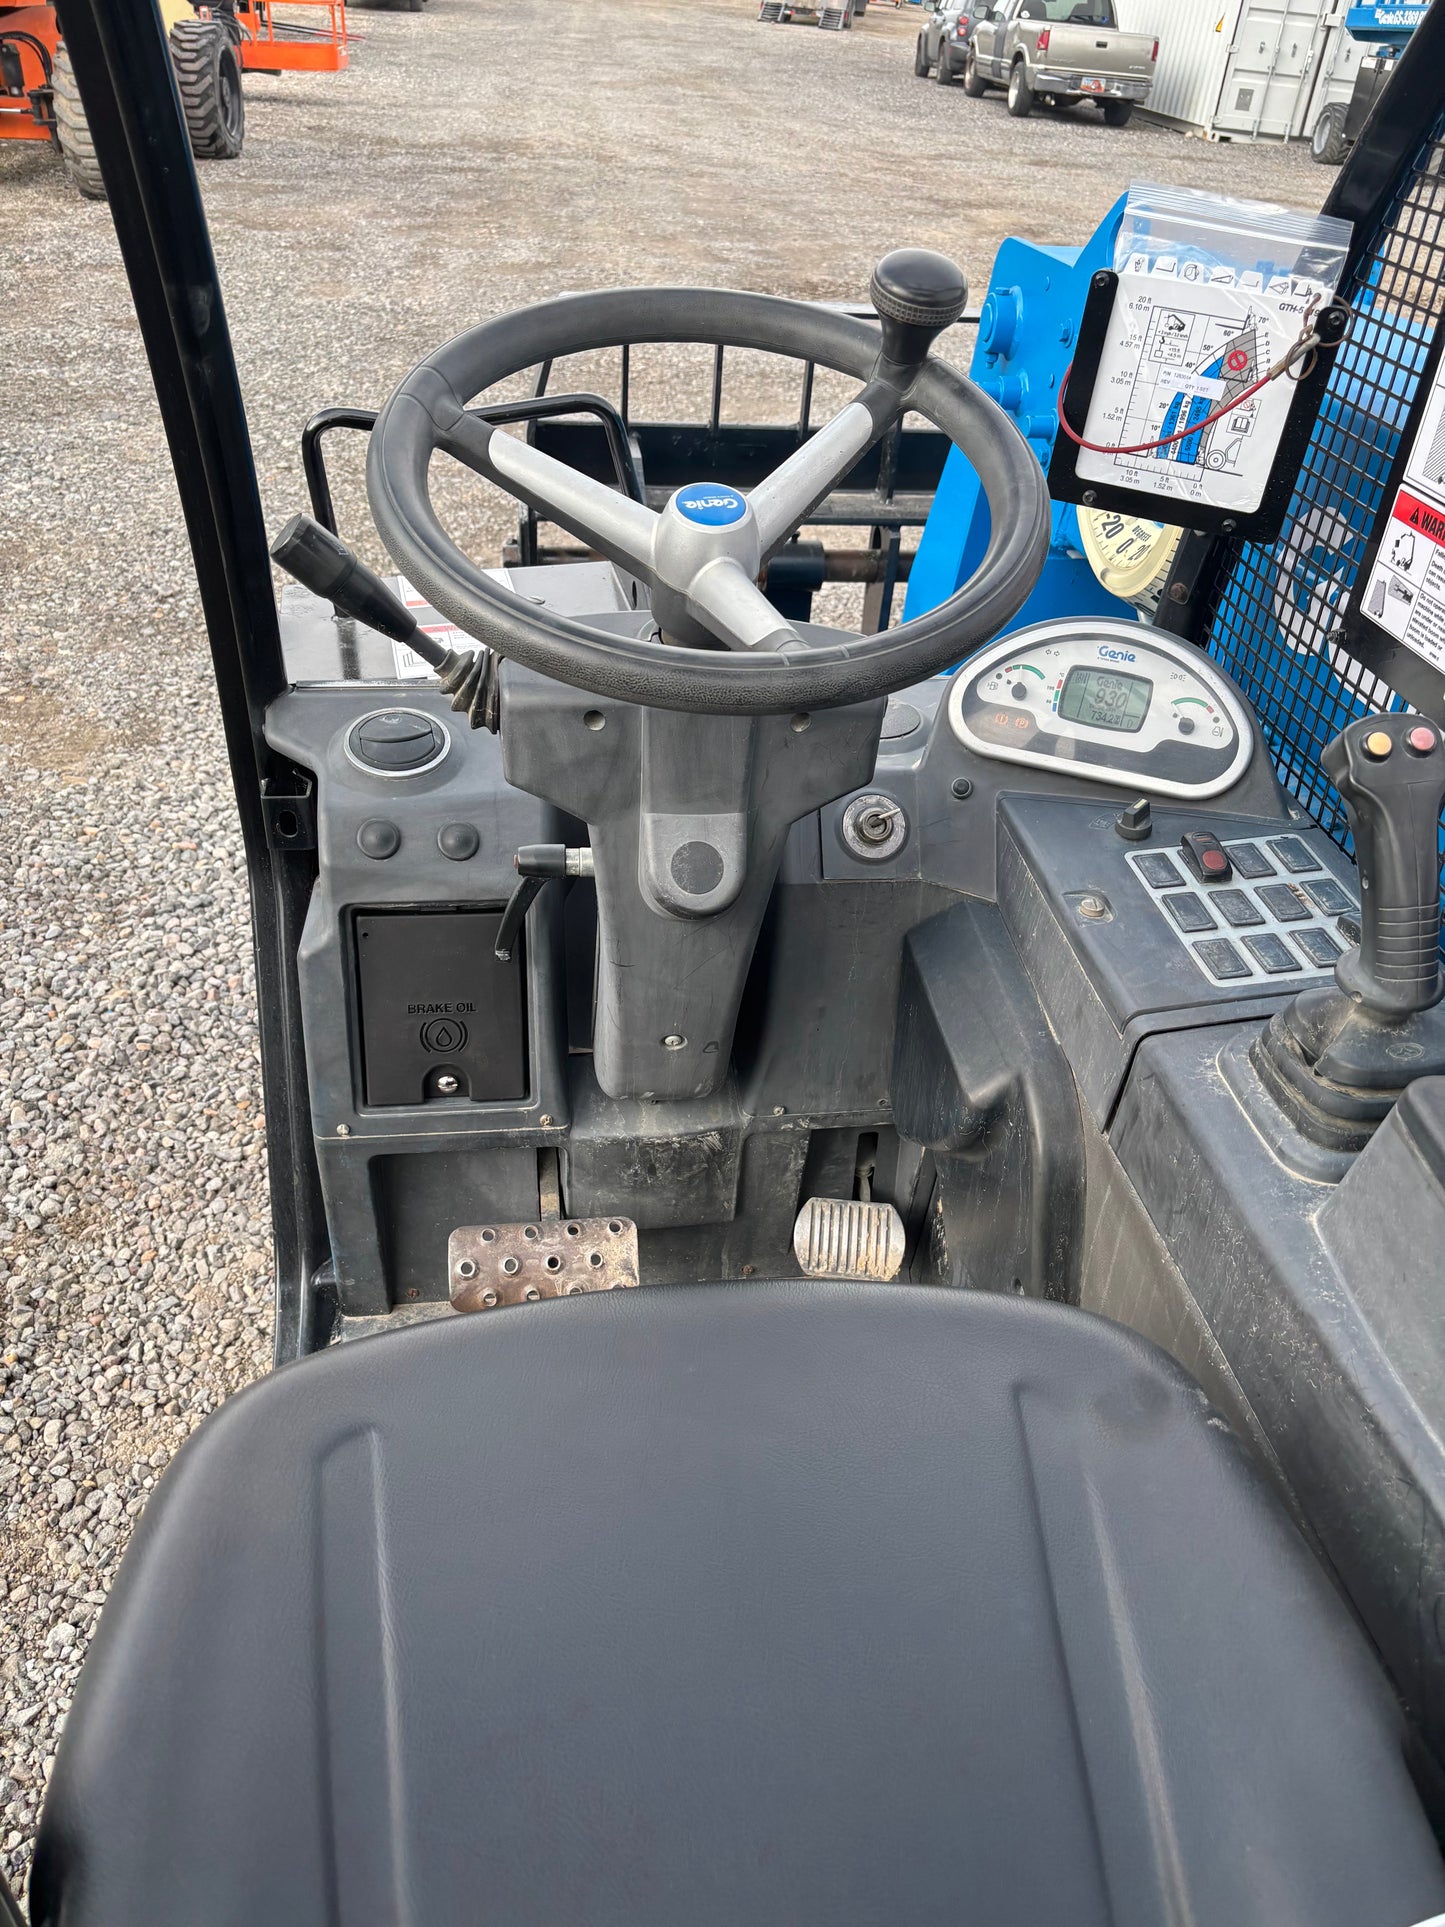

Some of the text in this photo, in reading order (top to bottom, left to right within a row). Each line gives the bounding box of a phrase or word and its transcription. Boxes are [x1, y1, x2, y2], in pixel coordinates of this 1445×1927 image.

[1138, 296, 1147, 304] 20
[1129, 302, 1142, 311] 6.10
[1279, 303, 1320, 317] GTH-519
[1119, 341, 1133, 349] 4.57
[1185, 361, 1196, 369] 40°
[1111, 377, 1124, 386] 3.05
[1103, 413, 1115, 421] 1.52
[1120, 475, 1132, 483] 3.05
[1154, 482, 1166, 490] 1.52
[682, 498, 738, 511] Genie
[1116, 538, 1134, 554] 0
[1099, 645, 1136, 663] Genie
[1097, 676, 1123, 691] Genie
[1095, 687, 1127, 708] 930
[407, 1002, 478, 1015] BRAKE OIL
